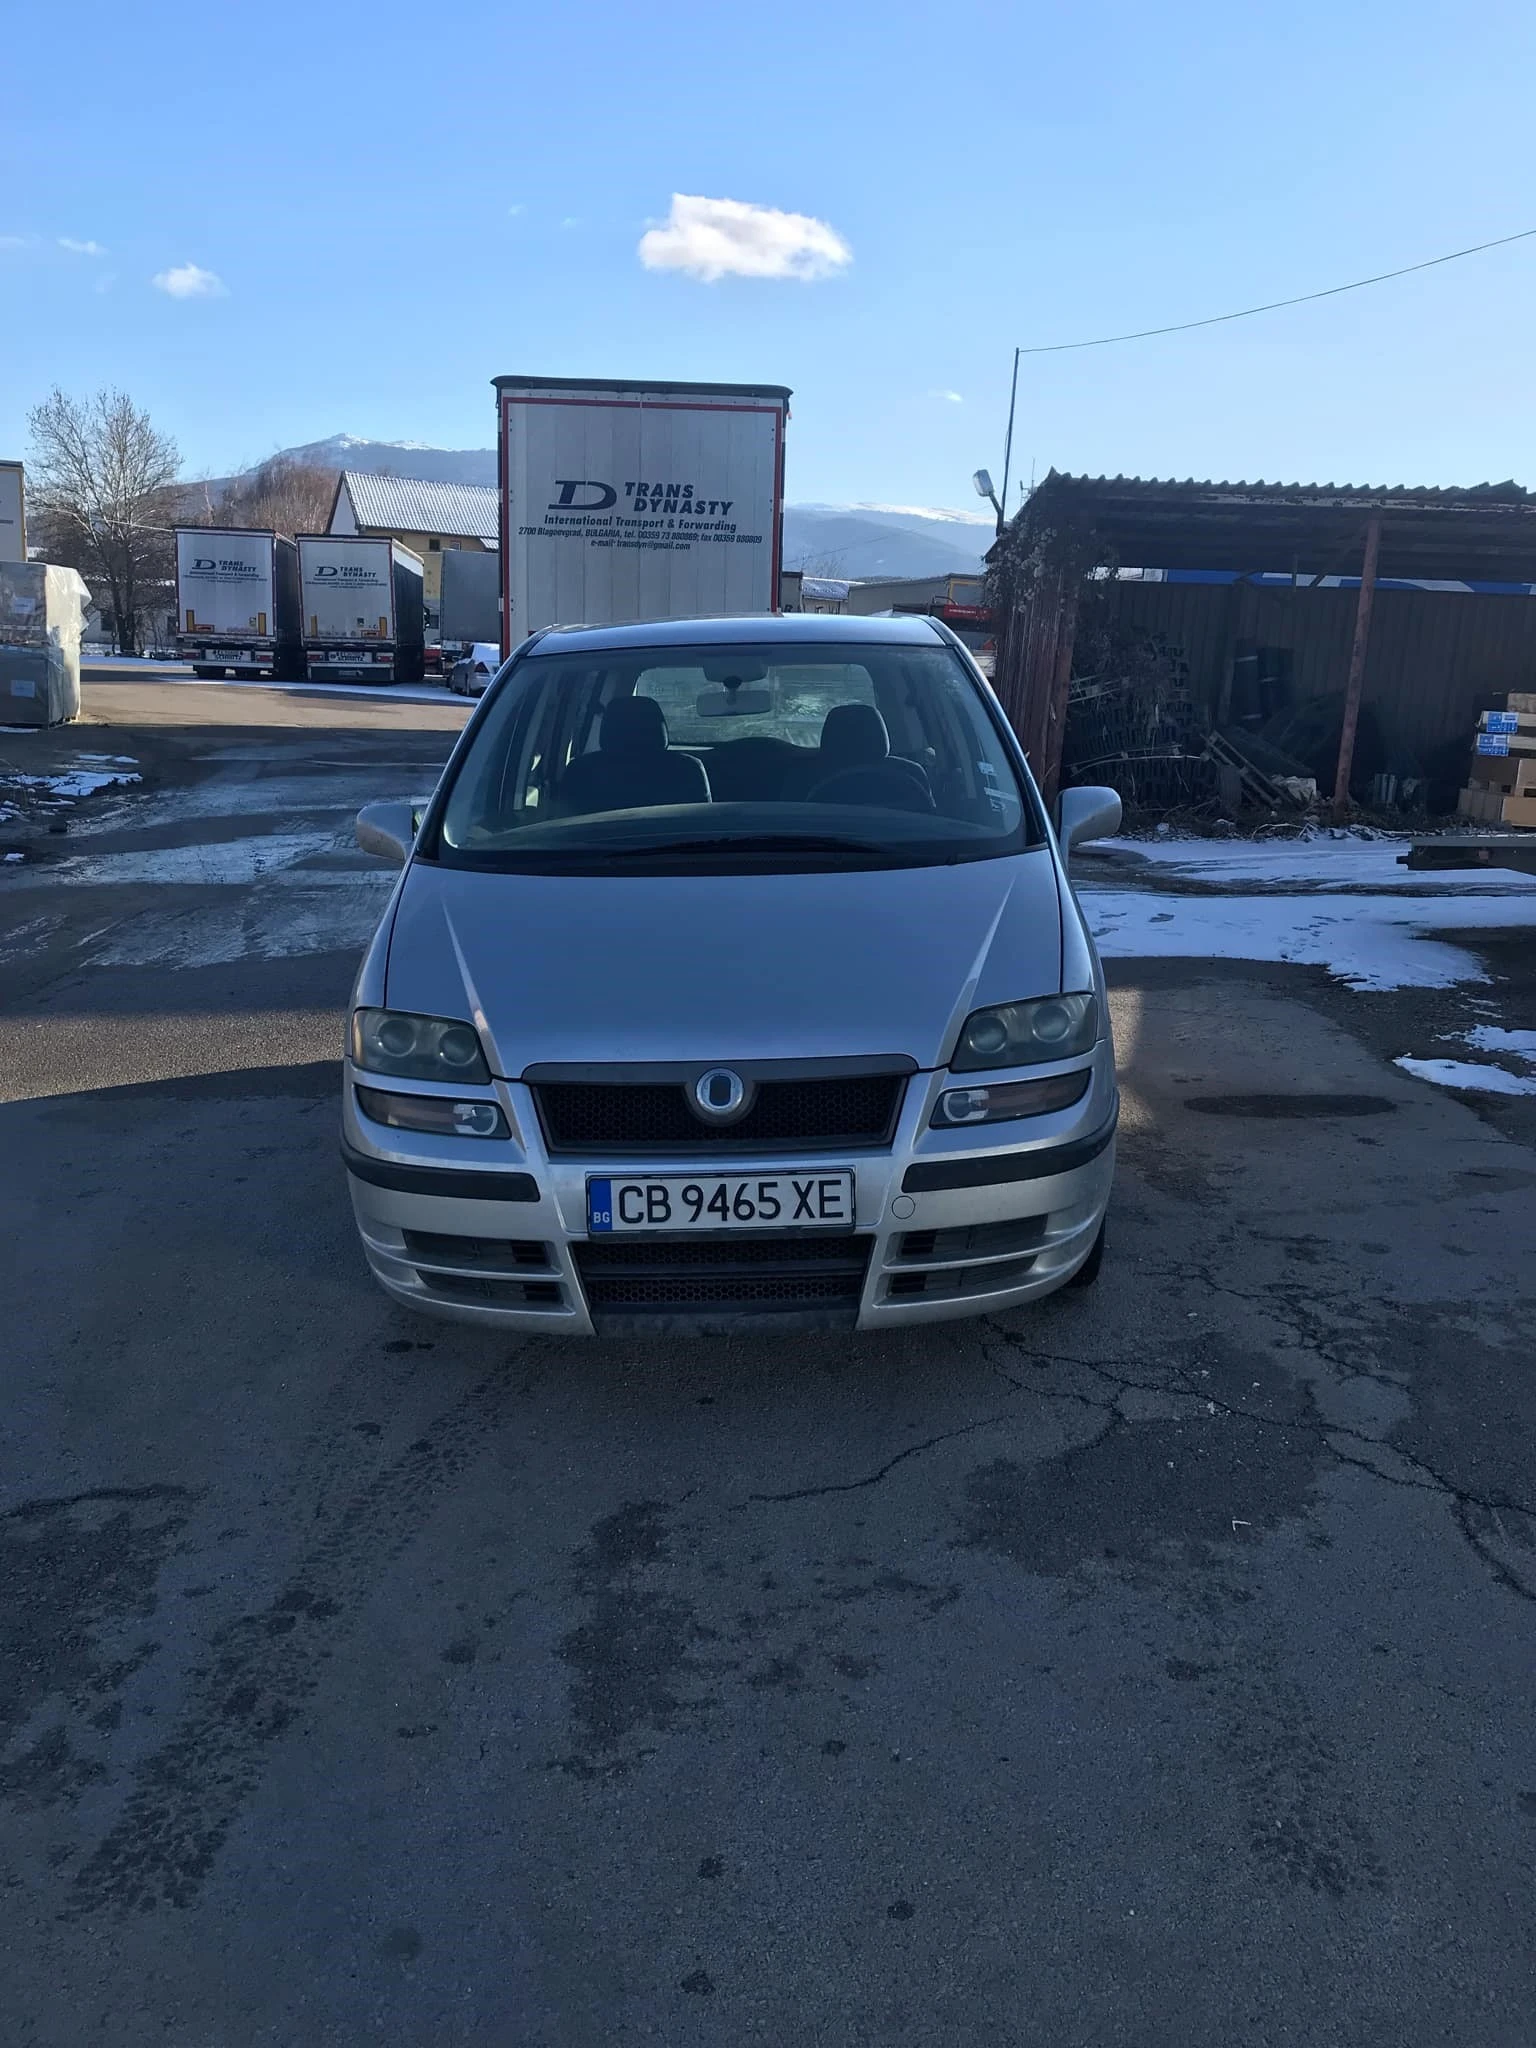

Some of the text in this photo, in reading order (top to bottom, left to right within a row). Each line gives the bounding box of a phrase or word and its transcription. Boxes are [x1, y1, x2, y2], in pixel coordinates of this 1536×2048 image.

[624, 481, 694, 499] TRANS
[633, 498, 734, 516] DYNASTY
[544, 514, 737, 533] International Transport & Forwarding
[518, 526, 537, 535] 2700
[624, 530, 635, 538] tel.
[661, 531, 670, 540] 73
[701, 533, 712, 541] fax
[618, 1179, 844, 1224] CB 9465 XE
[593, 1211, 610, 1224] BG
